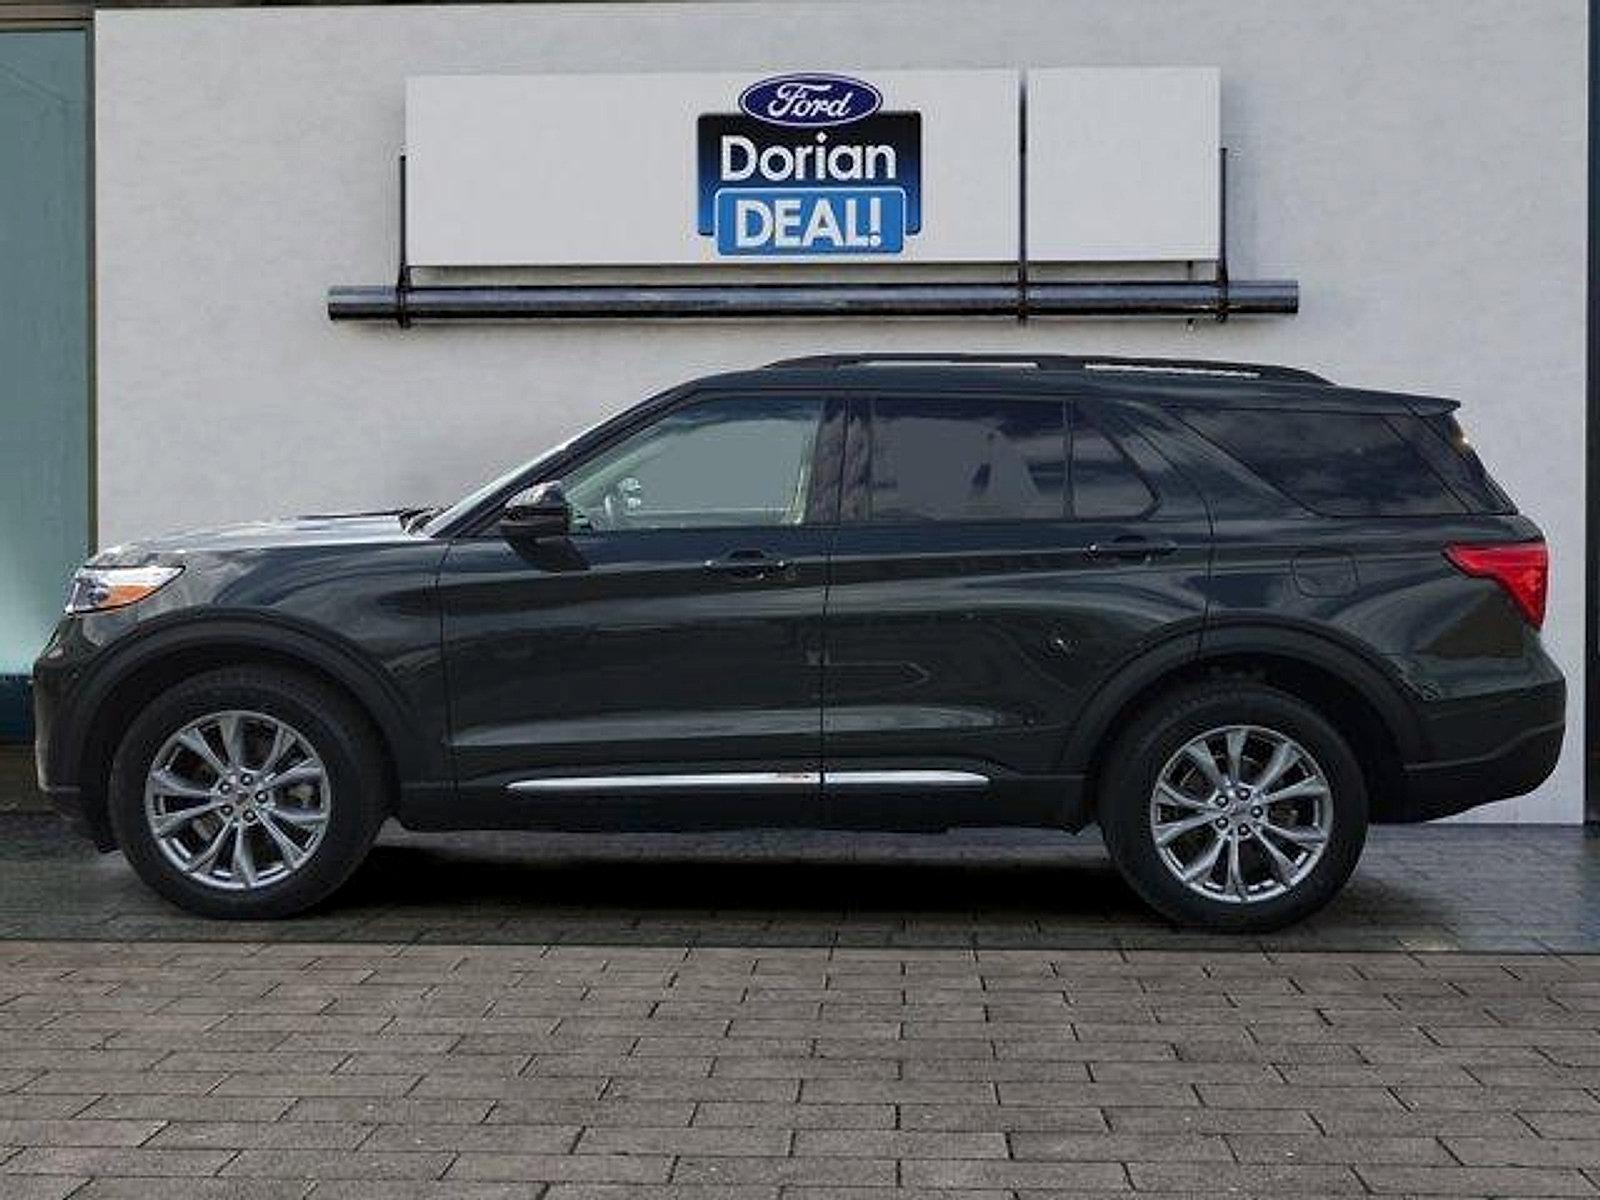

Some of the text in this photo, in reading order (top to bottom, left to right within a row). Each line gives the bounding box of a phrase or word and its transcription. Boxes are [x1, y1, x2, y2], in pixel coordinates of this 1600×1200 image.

[767, 82, 853, 118] Ford
[720, 132, 896, 181] Dorian
[735, 198, 882, 247] DEAL!
